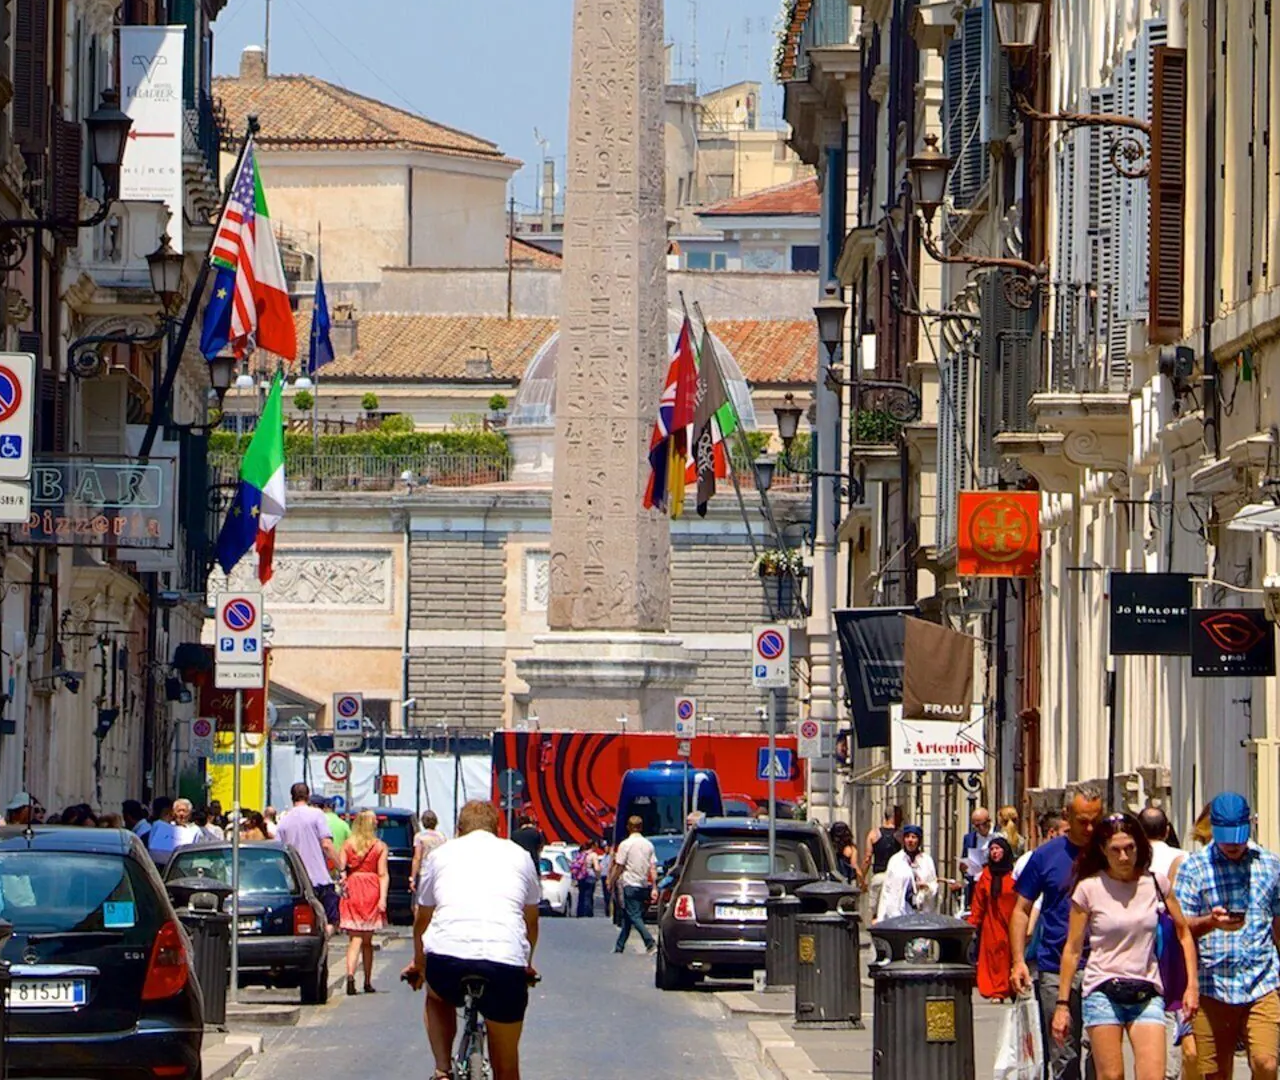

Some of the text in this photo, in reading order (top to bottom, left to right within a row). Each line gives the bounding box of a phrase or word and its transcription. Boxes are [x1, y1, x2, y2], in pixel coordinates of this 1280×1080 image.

[32, 467, 149, 504] BAR
[22, 509, 161, 537] Pizzeria
[1135, 604, 1187, 616] MALONE
[923, 703, 965, 715] FRAU
[331, 760, 346, 774] 20
[19, 982, 71, 1001] 815JY
